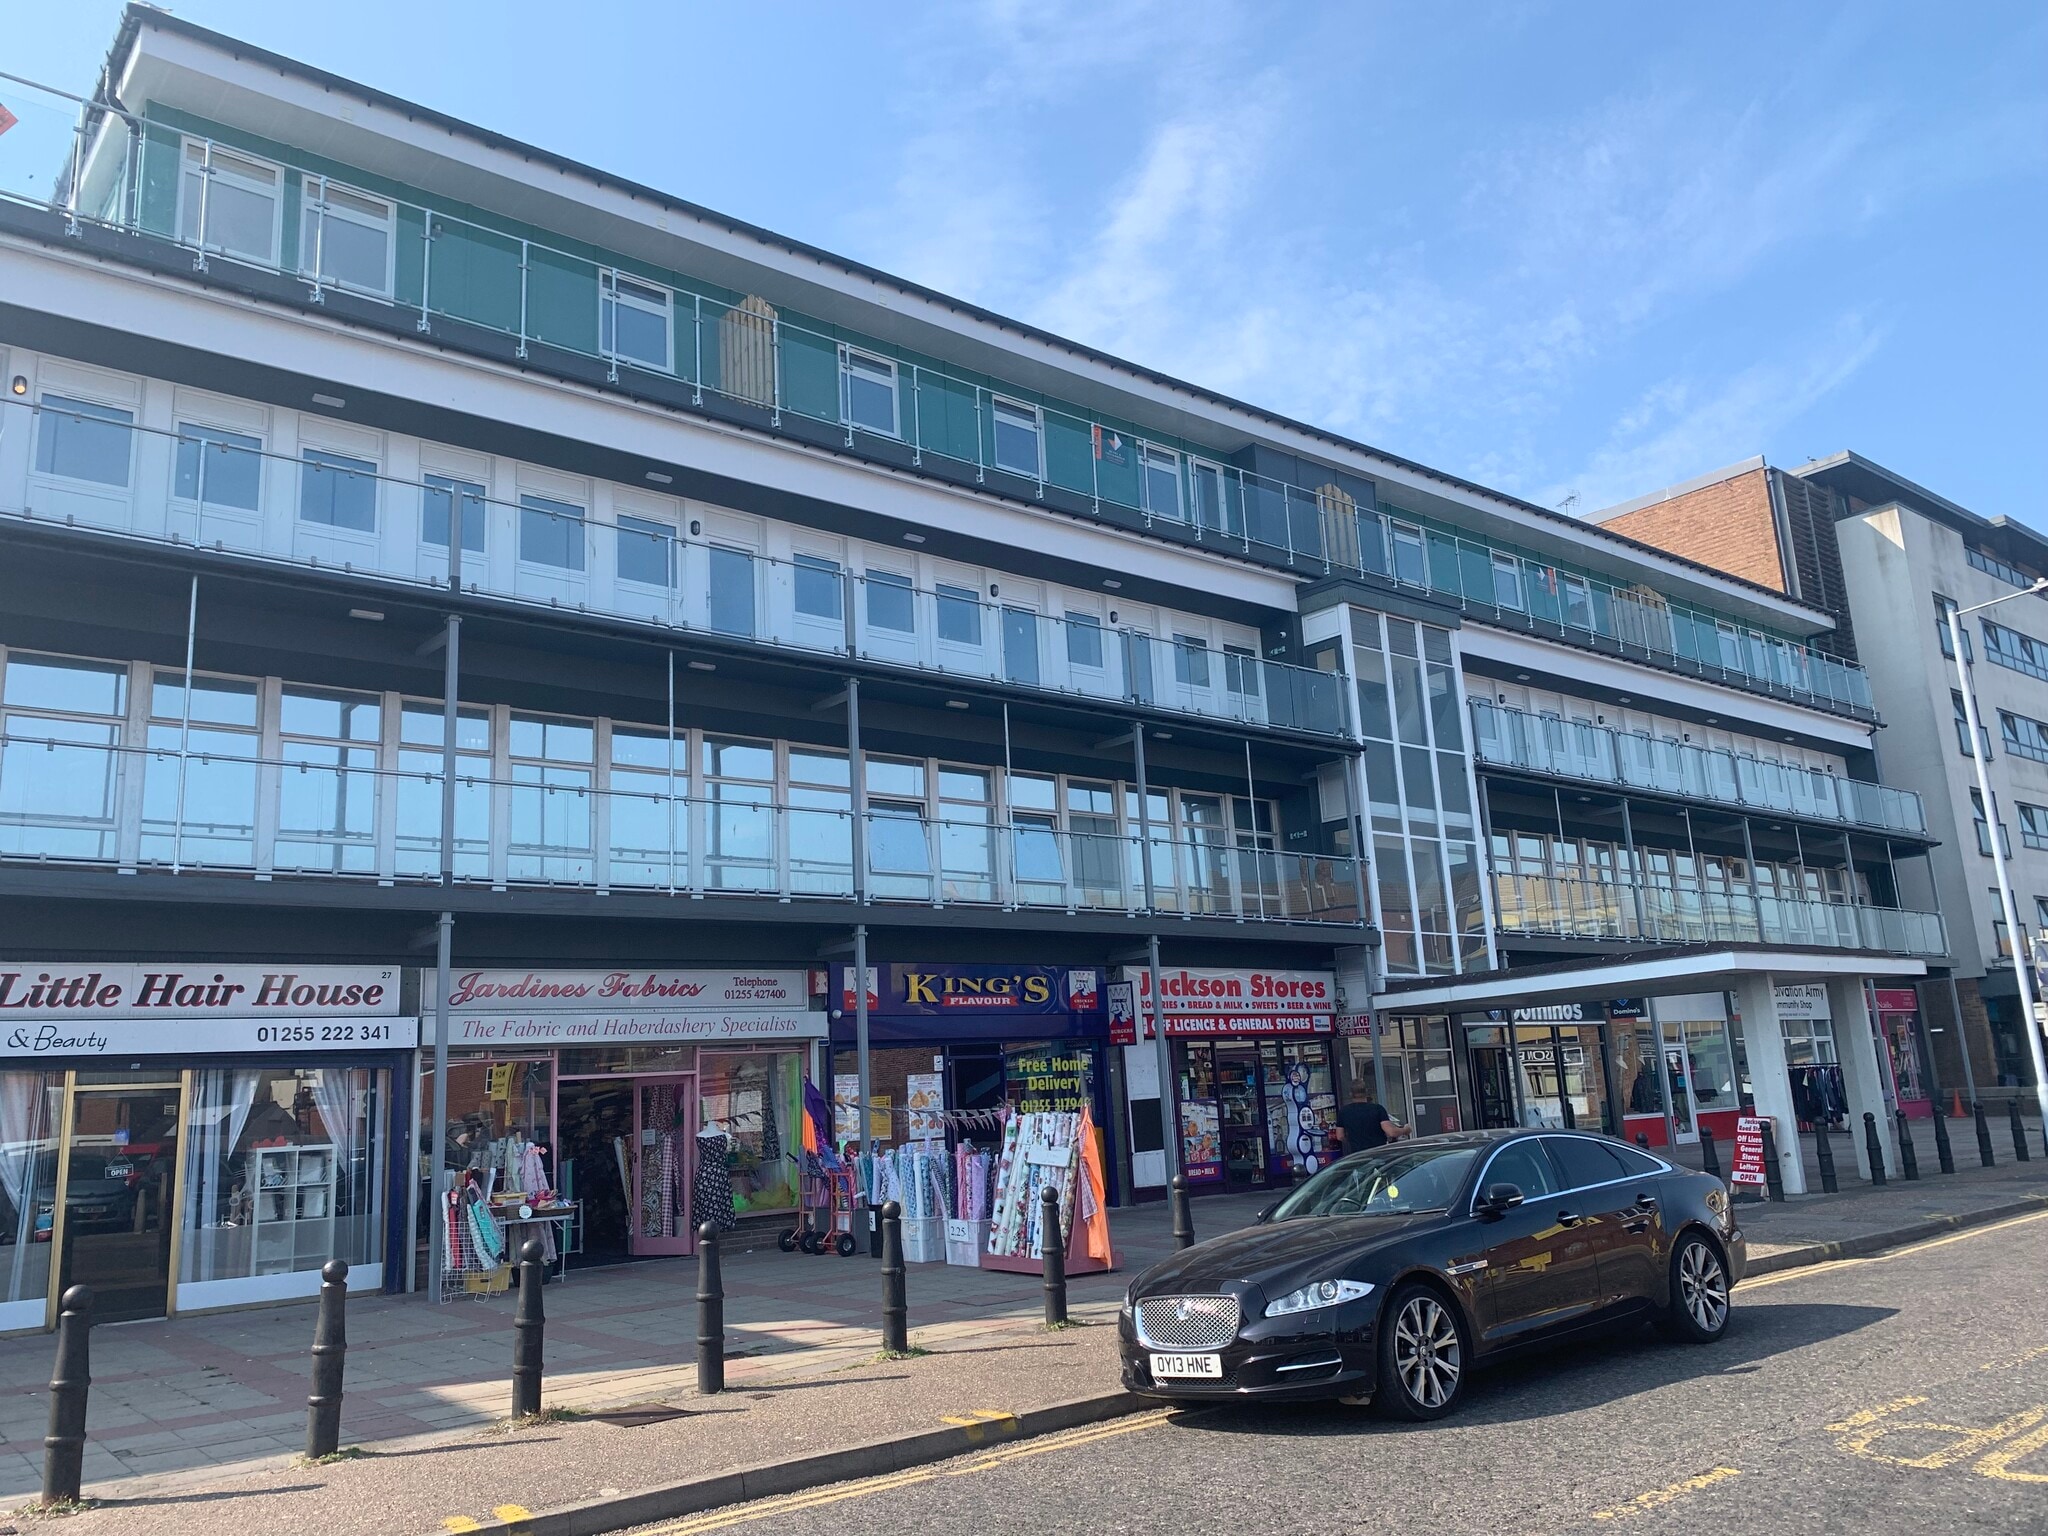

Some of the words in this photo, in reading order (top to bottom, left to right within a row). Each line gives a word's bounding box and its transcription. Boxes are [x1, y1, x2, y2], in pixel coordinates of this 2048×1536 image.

[381, 971, 392, 979] 27
[732, 976, 778, 987] Telephone
[1251, 974, 1326, 998] Stores
[0, 973, 122, 1008] Little
[132, 973, 245, 1008] Hair
[252, 974, 384, 1006] House
[448, 972, 595, 1005] Jardines
[597, 972, 707, 998] Fabrics
[724, 989, 752, 1000] 01255
[754, 988, 786, 1000] 427400
[906, 974, 1049, 1003] KING'S
[1805, 985, 1824, 1000] Army
[950, 997, 1011, 1005] FLAVOUR
[1187, 1001, 1214, 1009] BREAD
[1215, 1001, 1222, 1009] &
[1223, 1001, 1243, 1009] MILK
[1313, 1002, 1331, 1010] WINE
[1800, 1001, 1812, 1010] Shop
[1613, 1007, 1641, 1015] Domino's
[462, 1020, 495, 1038] The
[501, 1019, 562, 1038] Fabric
[566, 1019, 598, 1037] and
[603, 1018, 716, 1037] Haberdashery
[721, 1016, 798, 1035] Specialists
[1174, 1017, 1217, 1031] LICENCE
[1218, 1018, 1227, 1030] &
[1229, 1017, 1274, 1031] GENERAL
[1276, 1017, 1310, 1030] STORES
[7, 1029, 29, 1047] &
[34, 1025, 108, 1051] Beauty
[257, 1027, 315, 1042] 01255
[321, 1027, 354, 1041] 222
[360, 1025, 391, 1040] 341
[1018, 1058, 1048, 1072] Free
[1052, 1057, 1089, 1071] Home
[1027, 1076, 1080, 1093] Delivery
[1020, 1098, 1050, 1113] 01255
[1737, 1134, 1747, 1142] Off
[1747, 1135, 1763, 1143] Licen
[1740, 1145, 1763, 1153] General
[1741, 1153, 1760, 1161] Stores
[111, 1169, 129, 1177] OPEN
[1188, 1168, 1201, 1177] BREAD
[1204, 1167, 1215, 1175] MILK
[1739, 1163, 1760, 1172] Lottery
[1740, 1173, 1757, 1181] OPEN
[1157, 1356, 1184, 1372] OY13
[1187, 1356, 1211, 1373] HNE
